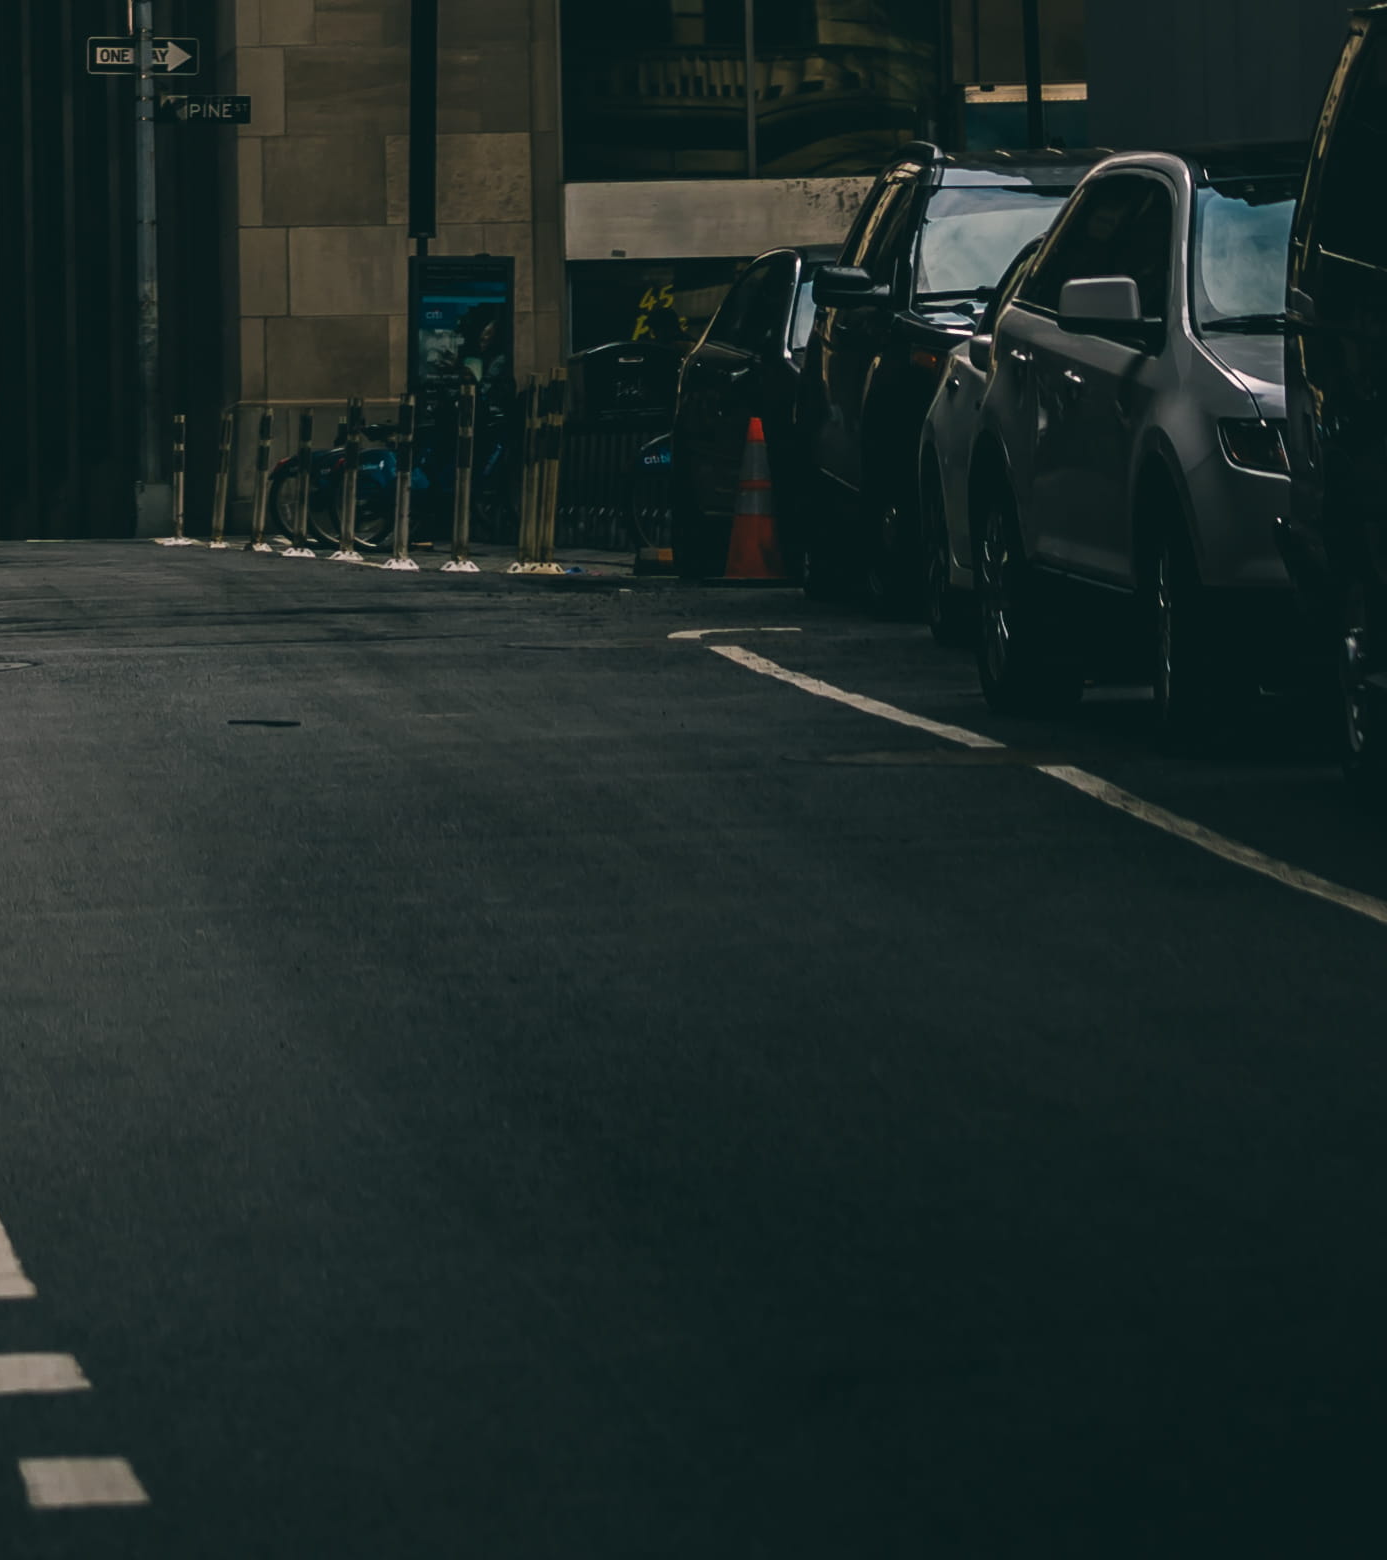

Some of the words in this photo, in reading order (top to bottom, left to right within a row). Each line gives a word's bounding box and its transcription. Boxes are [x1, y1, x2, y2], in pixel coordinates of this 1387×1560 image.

[99, 49, 130, 63] ONE
[152, 50, 169, 63] AY
[189, 103, 233, 119] PINE
[638, 284, 675, 311] 45
